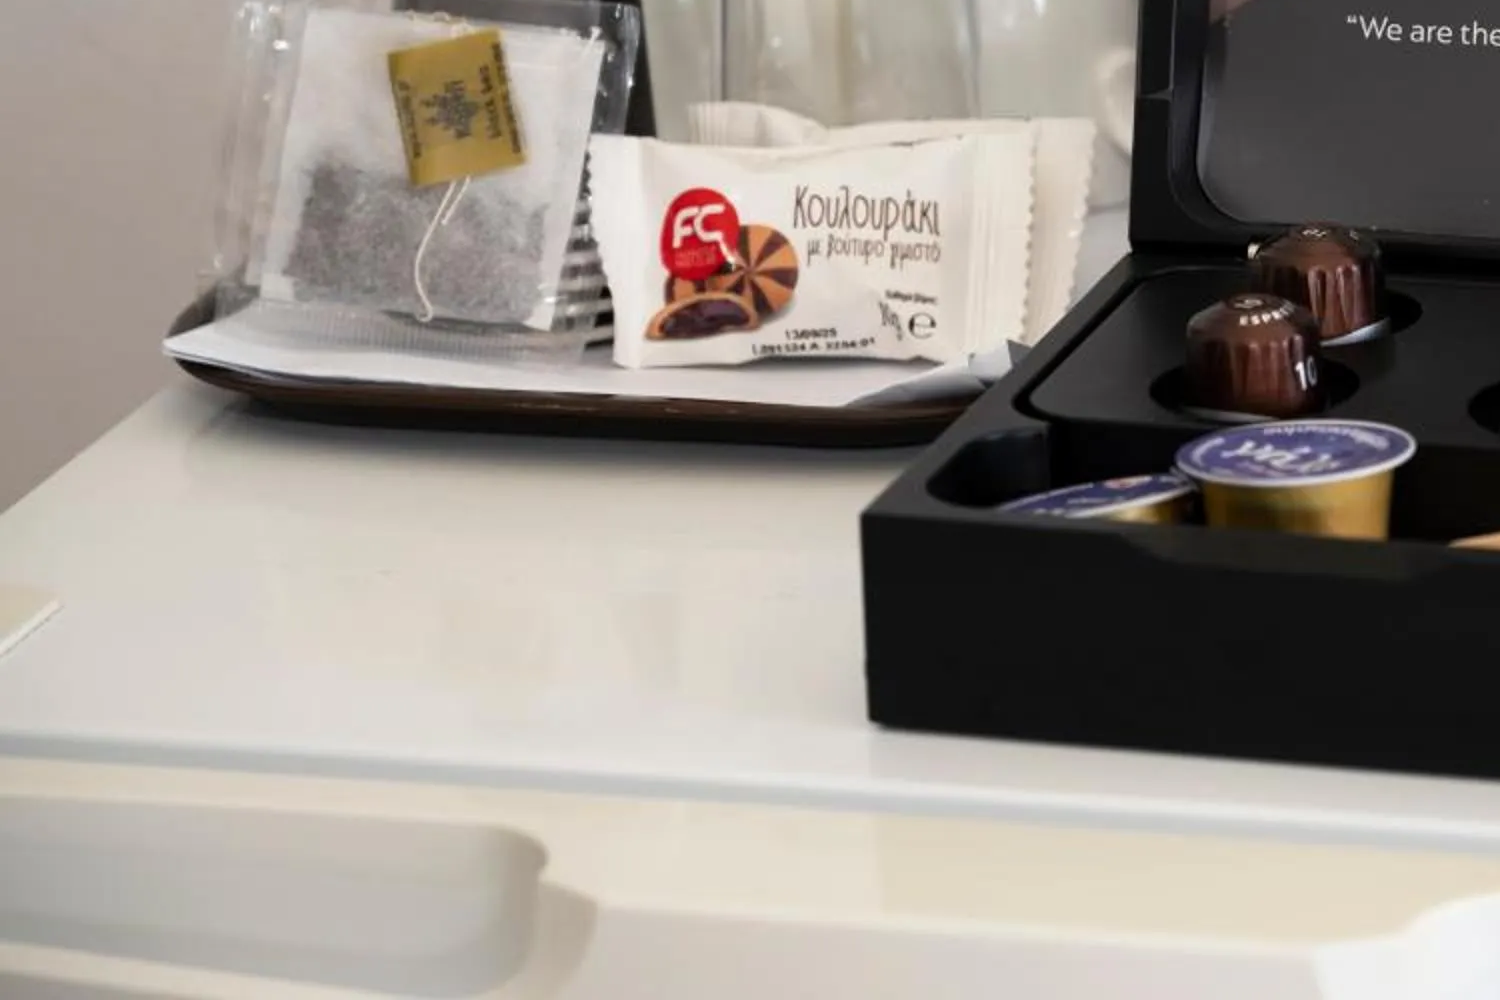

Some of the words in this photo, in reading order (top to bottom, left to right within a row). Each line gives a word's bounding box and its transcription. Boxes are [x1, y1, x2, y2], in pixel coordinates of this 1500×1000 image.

[1409, 23, 1453, 44] are
[793, 183, 941, 242] Κουλουράκι
[1294, 355, 1318, 391] 10
